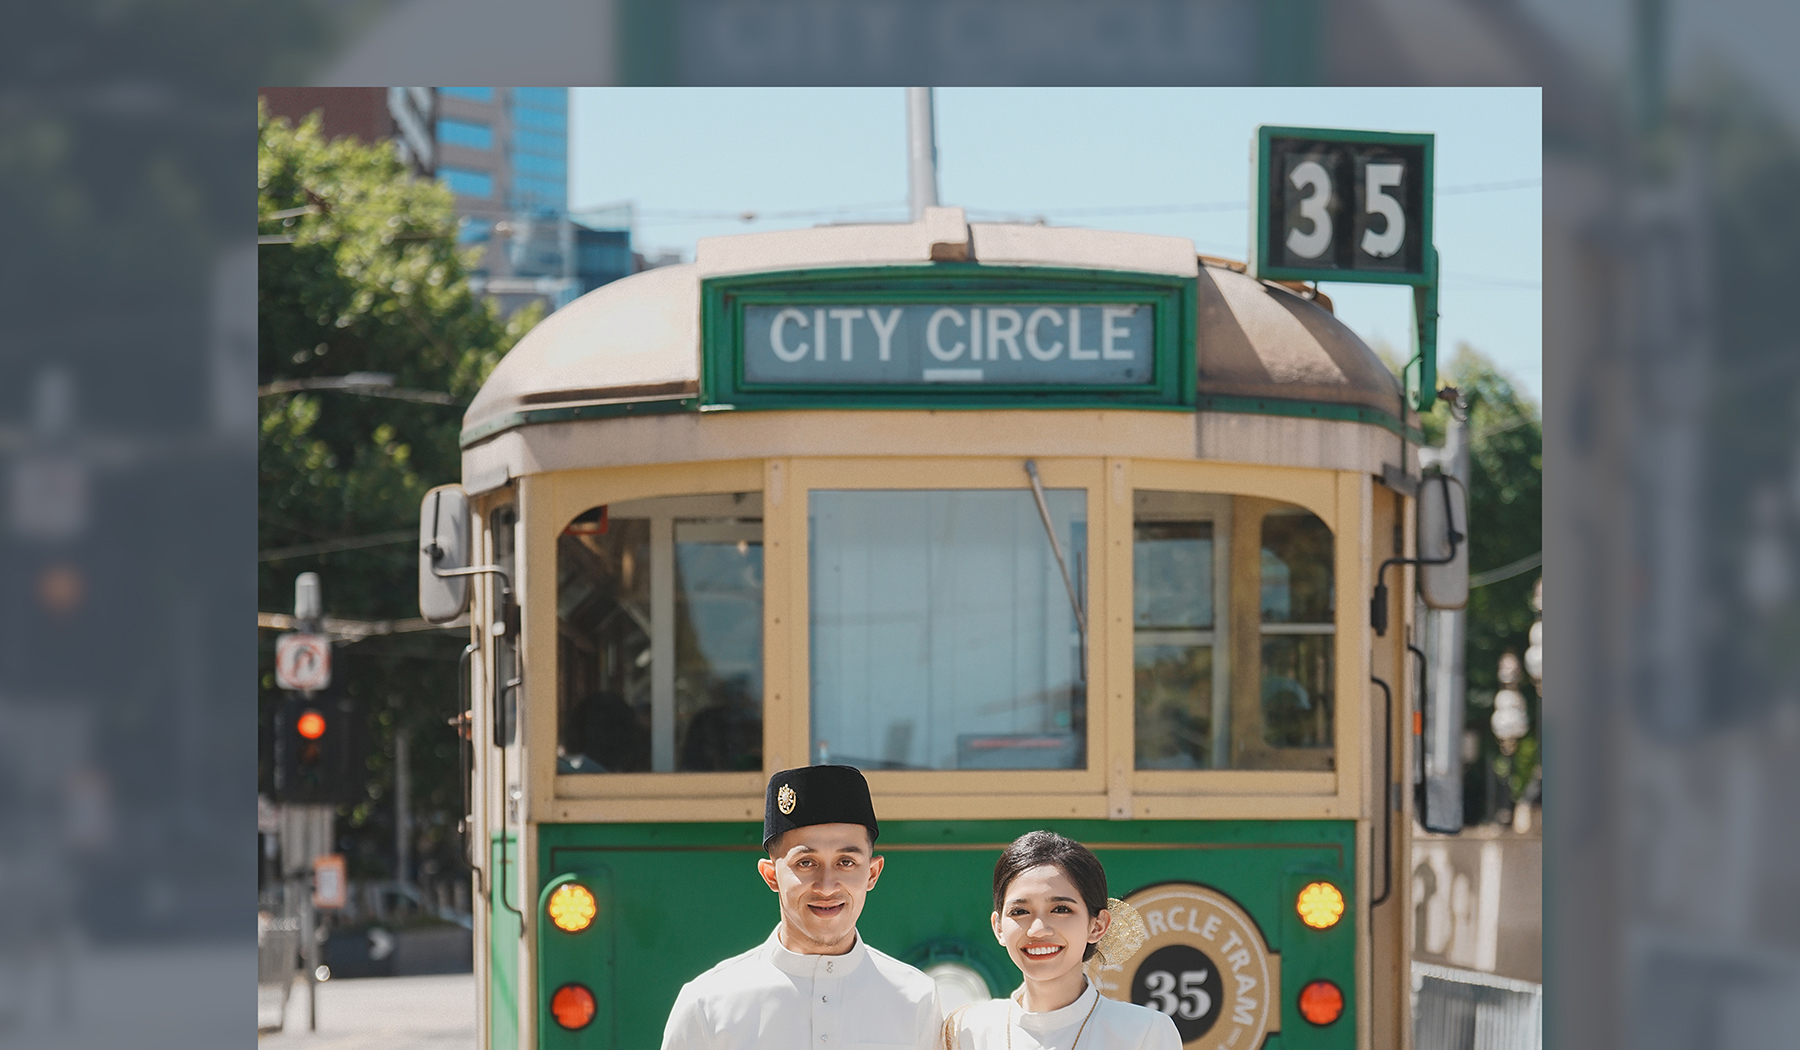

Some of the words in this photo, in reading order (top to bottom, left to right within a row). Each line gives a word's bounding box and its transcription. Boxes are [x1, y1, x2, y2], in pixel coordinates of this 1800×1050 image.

[1286, 161, 1406, 259] 35
[770, 308, 904, 362] CITY
[925, 308, 1135, 362] CIRCLE
[1143, 905, 1222, 941] RCLE
[1221, 930, 1257, 1026] TRAM
[1145, 968, 1212, 1020] 35
